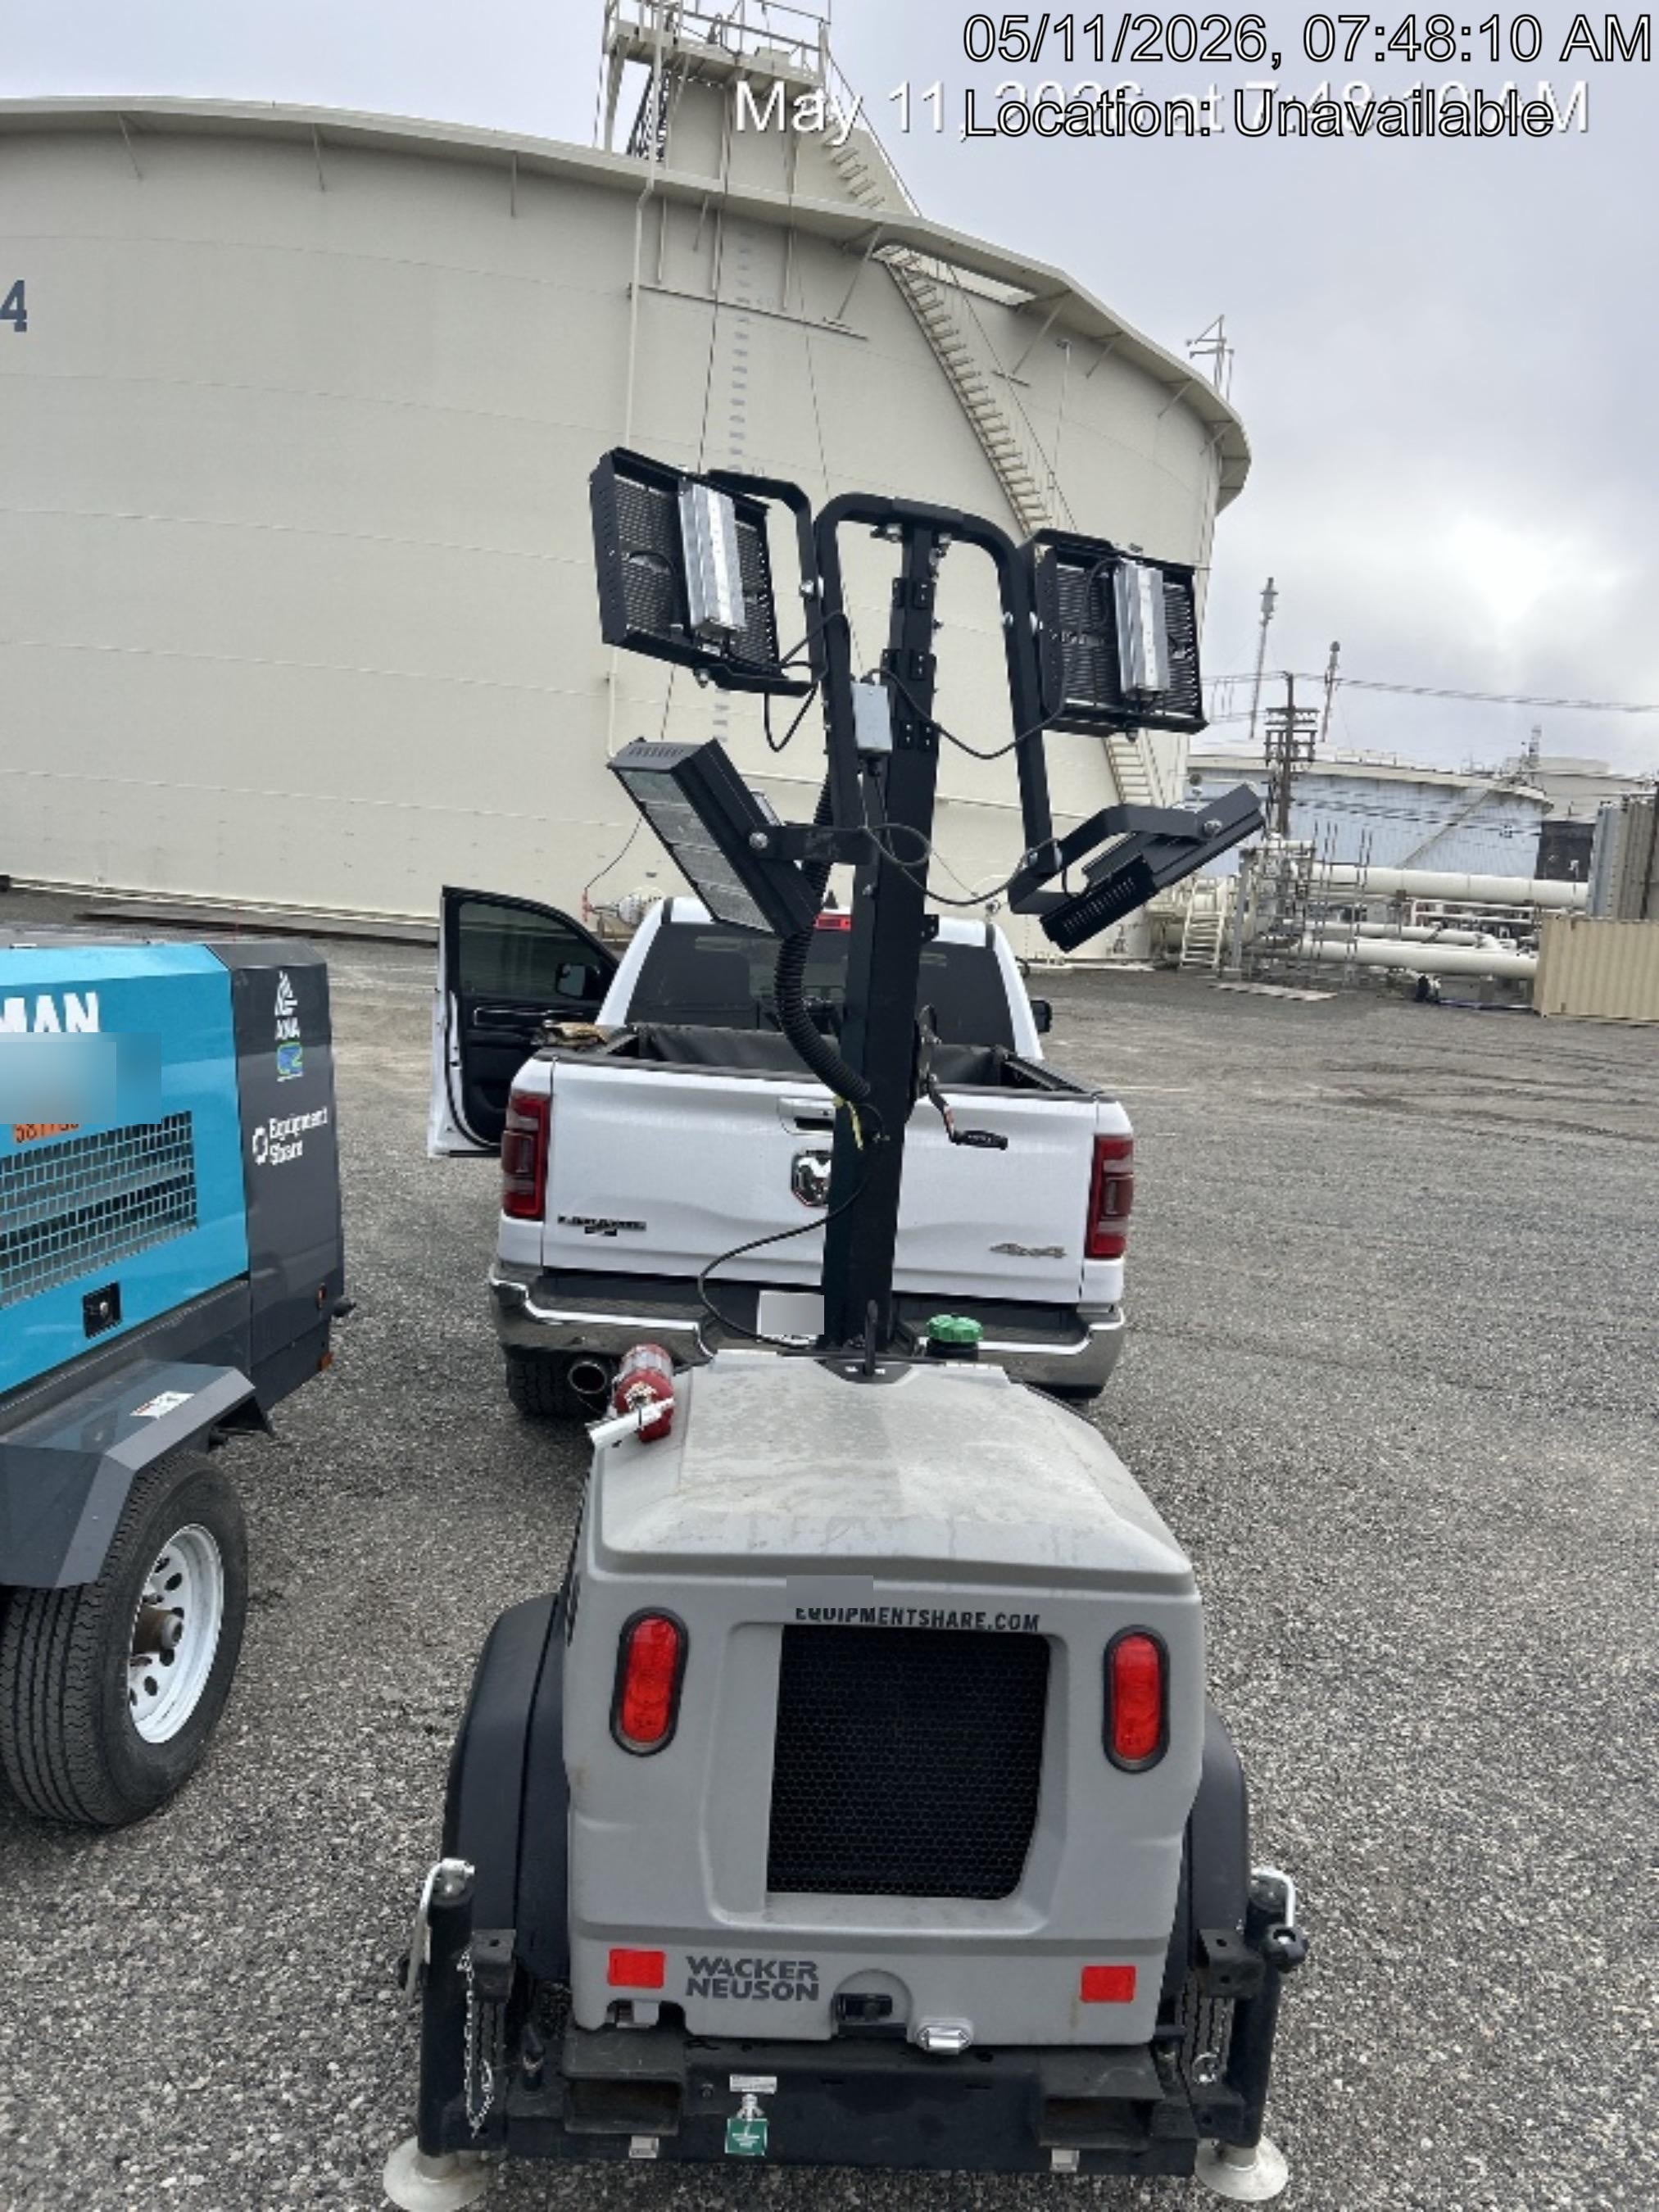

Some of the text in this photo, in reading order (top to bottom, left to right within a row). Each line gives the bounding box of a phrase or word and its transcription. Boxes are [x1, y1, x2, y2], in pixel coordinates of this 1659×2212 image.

[0, 279, 28, 333] 4
[795, 1607, 1040, 1632] EQUIPMENTSHARE.COM
[685, 1956, 819, 1981] WACKER
[685, 1977, 819, 2001] NEUSON
